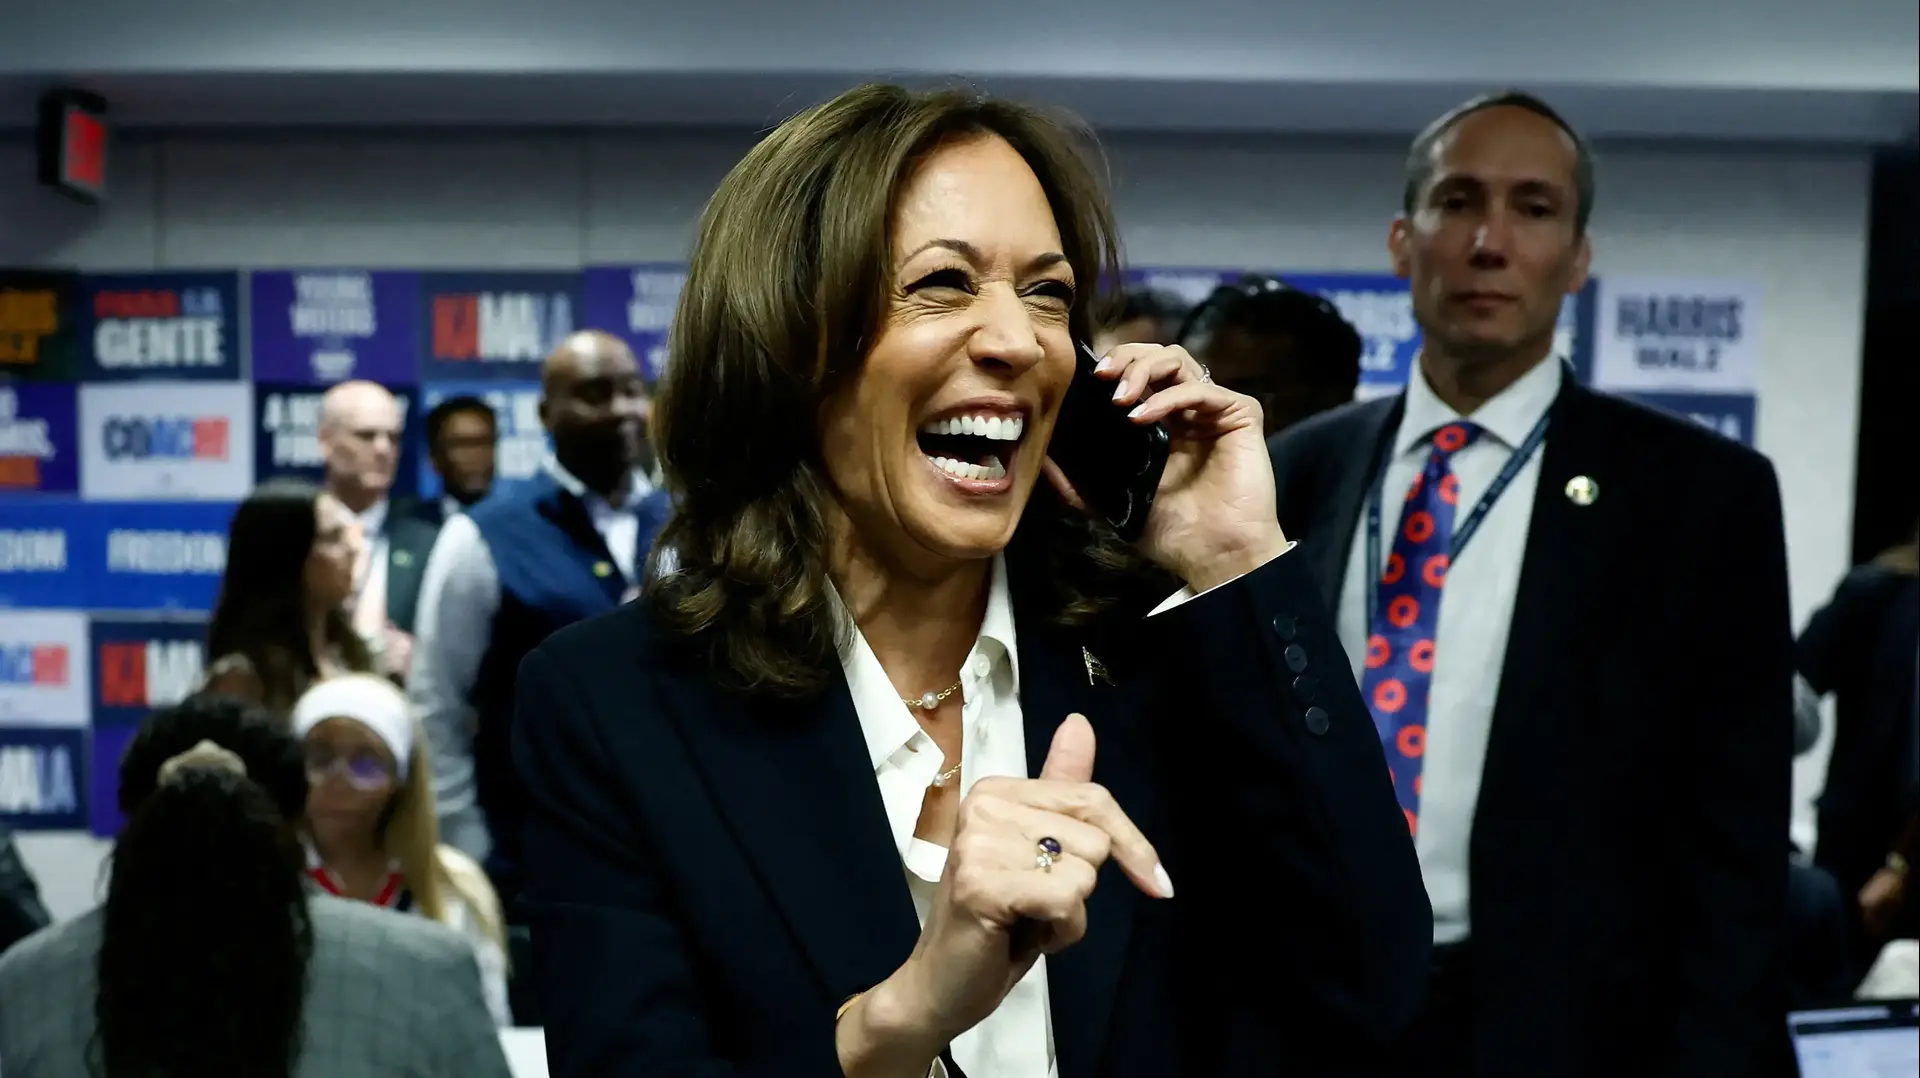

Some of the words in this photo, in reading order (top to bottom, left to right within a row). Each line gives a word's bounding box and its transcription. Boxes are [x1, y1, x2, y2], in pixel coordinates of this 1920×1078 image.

[1616, 297, 1742, 339] HARRIS
[95, 318, 223, 368] GENTE
[1636, 346, 1718, 370] WALZ
[102, 640, 205, 706] KAMA
